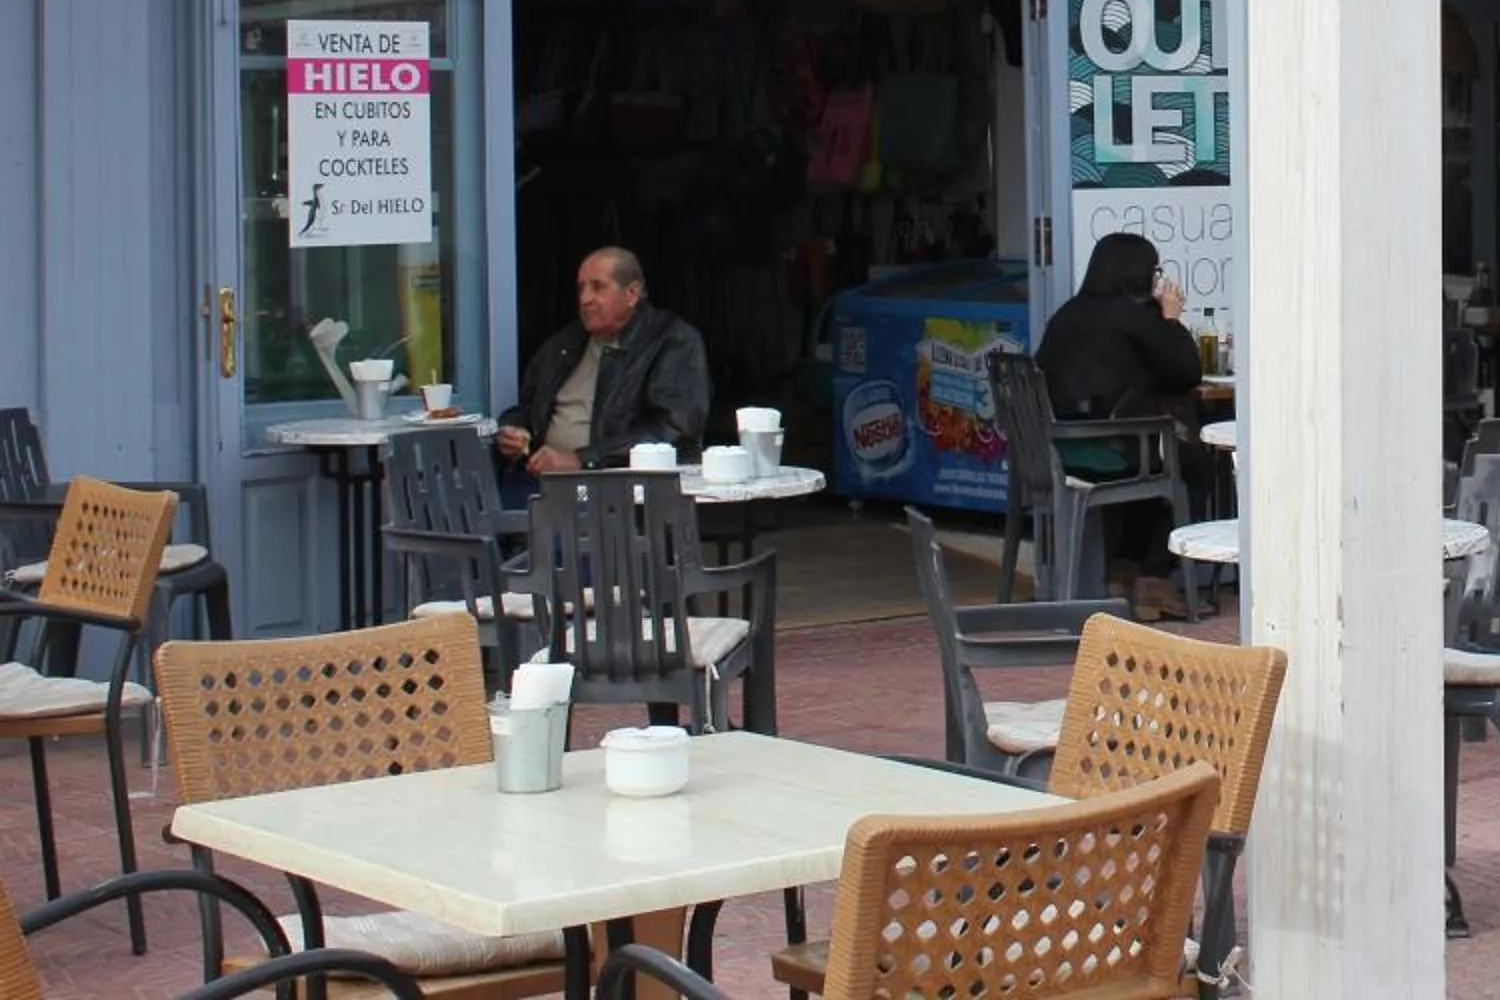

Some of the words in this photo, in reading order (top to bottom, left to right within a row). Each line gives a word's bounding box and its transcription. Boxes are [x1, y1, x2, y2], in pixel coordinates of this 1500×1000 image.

[318, 34, 373, 54] VENTA
[379, 34, 400, 54] DE
[304, 61, 421, 92] HIELO
[315, 102, 337, 119] EN
[342, 101, 411, 119] CUBITOS
[1094, 75, 1230, 163] LET
[337, 131, 348, 147] Y
[352, 130, 391, 147] PARA
[319, 157, 408, 177] COCKTELES
[351, 200, 373, 215] Del
[378, 198, 425, 214] HIELO
[1091, 202, 1233, 242] casua
